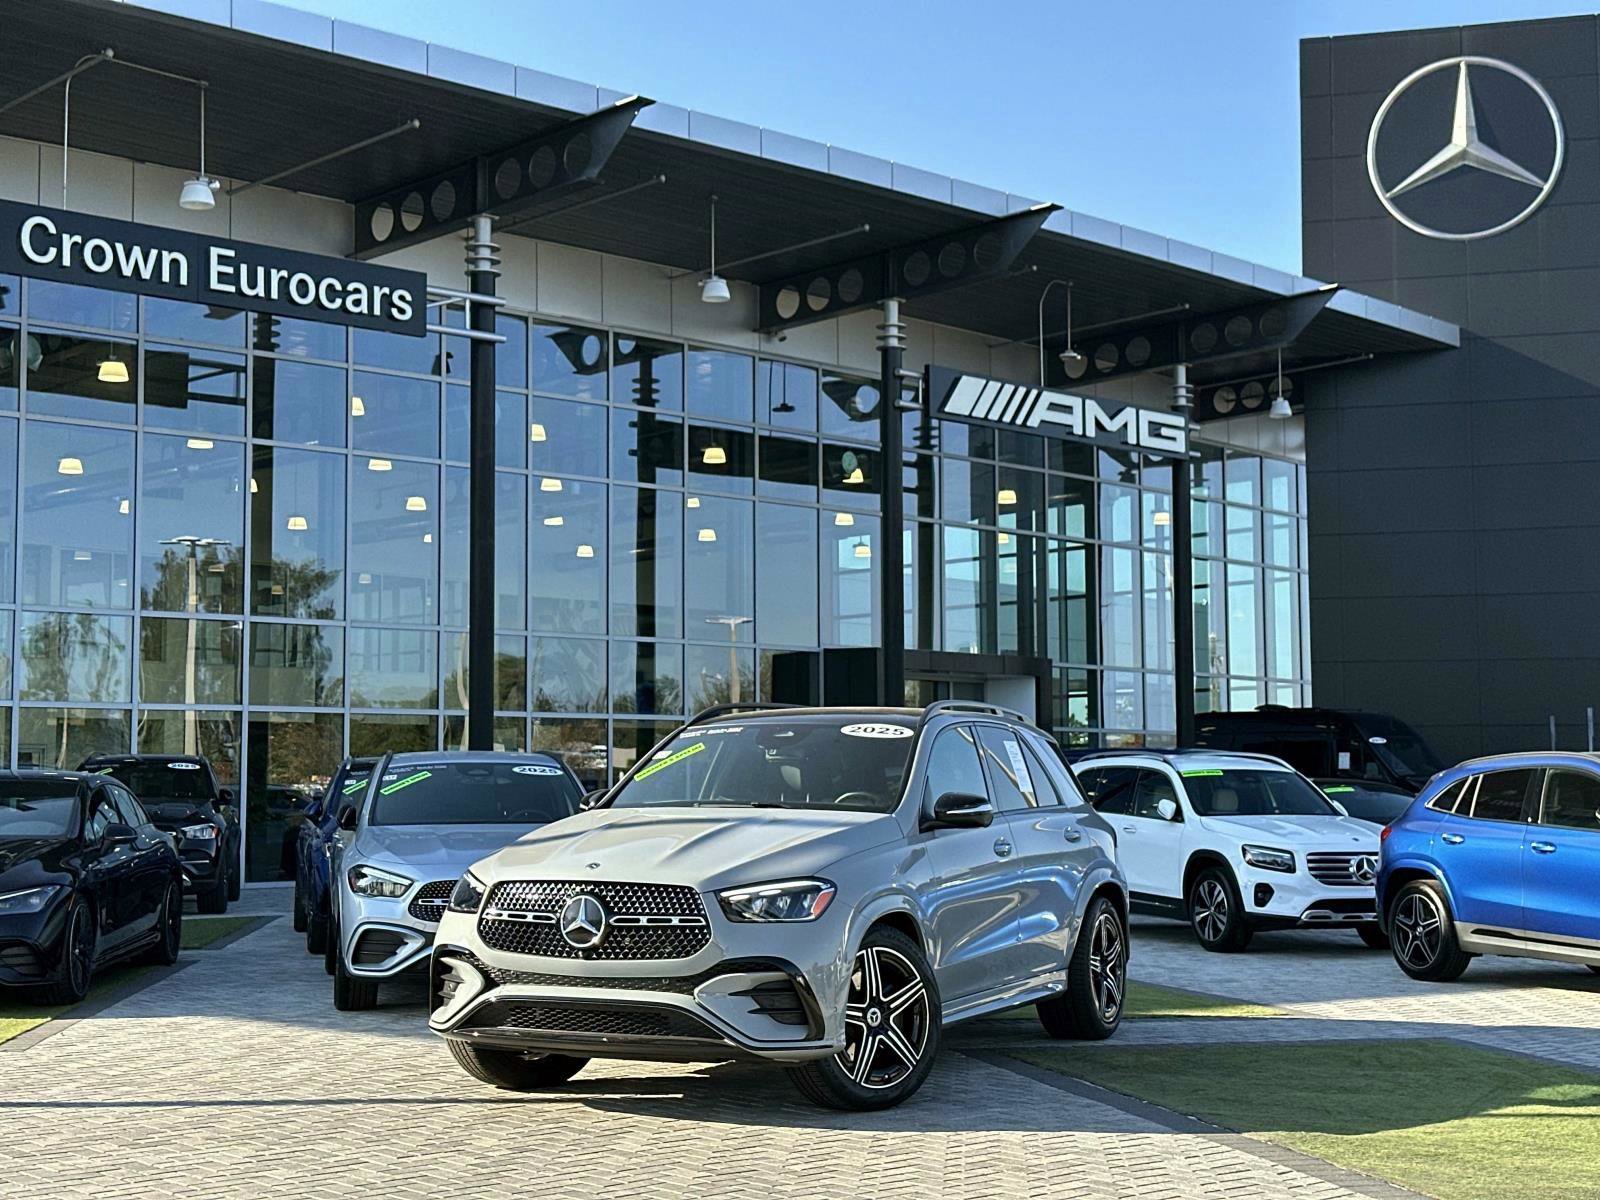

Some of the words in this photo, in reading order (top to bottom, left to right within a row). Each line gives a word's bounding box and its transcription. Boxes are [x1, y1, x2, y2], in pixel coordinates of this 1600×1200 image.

[20, 216, 188, 286] Crown
[209, 246, 413, 321] Eurocars
[1026, 390, 1186, 453] AMG
[849, 726, 905, 736] 2025
[517, 767, 558, 775] 2025
